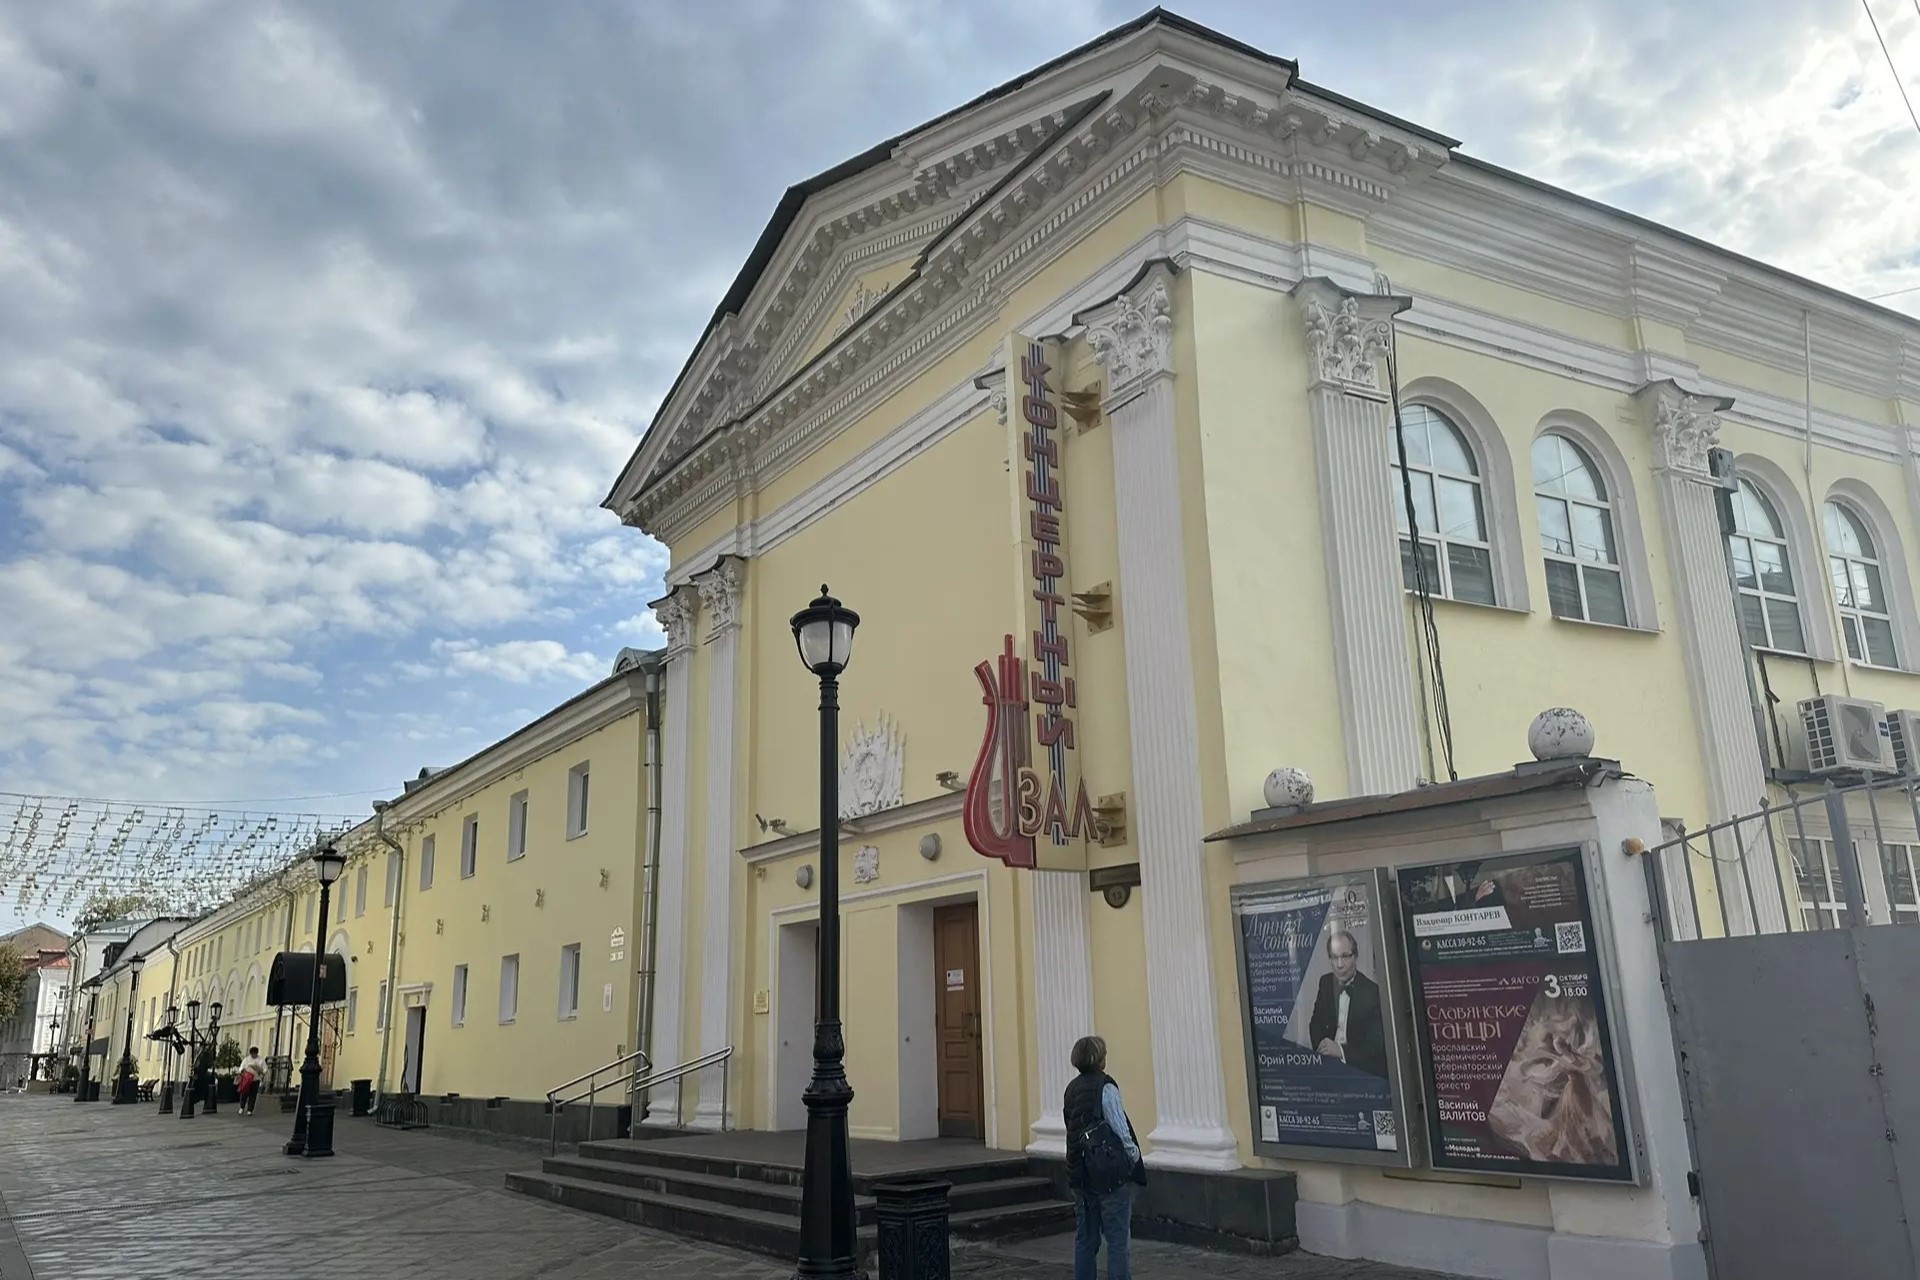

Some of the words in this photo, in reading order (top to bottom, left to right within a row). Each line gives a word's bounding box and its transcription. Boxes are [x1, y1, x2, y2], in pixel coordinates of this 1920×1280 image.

[1021, 354, 1076, 749] КОНЦЕРТНЫЙ
[1017, 767, 1099, 840] ЗАЛ
[1543, 974, 1561, 998] 3
[1253, 1006, 1283, 1015] Василий
[1254, 1015, 1289, 1025] ВАЛИТОВ
[1258, 1053, 1286, 1068] Юрий
[1287, 1054, 1322, 1066] РОЗУМ
[1438, 1099, 1479, 1110] Василий
[1439, 1110, 1487, 1121] ВАЛИТОВ
